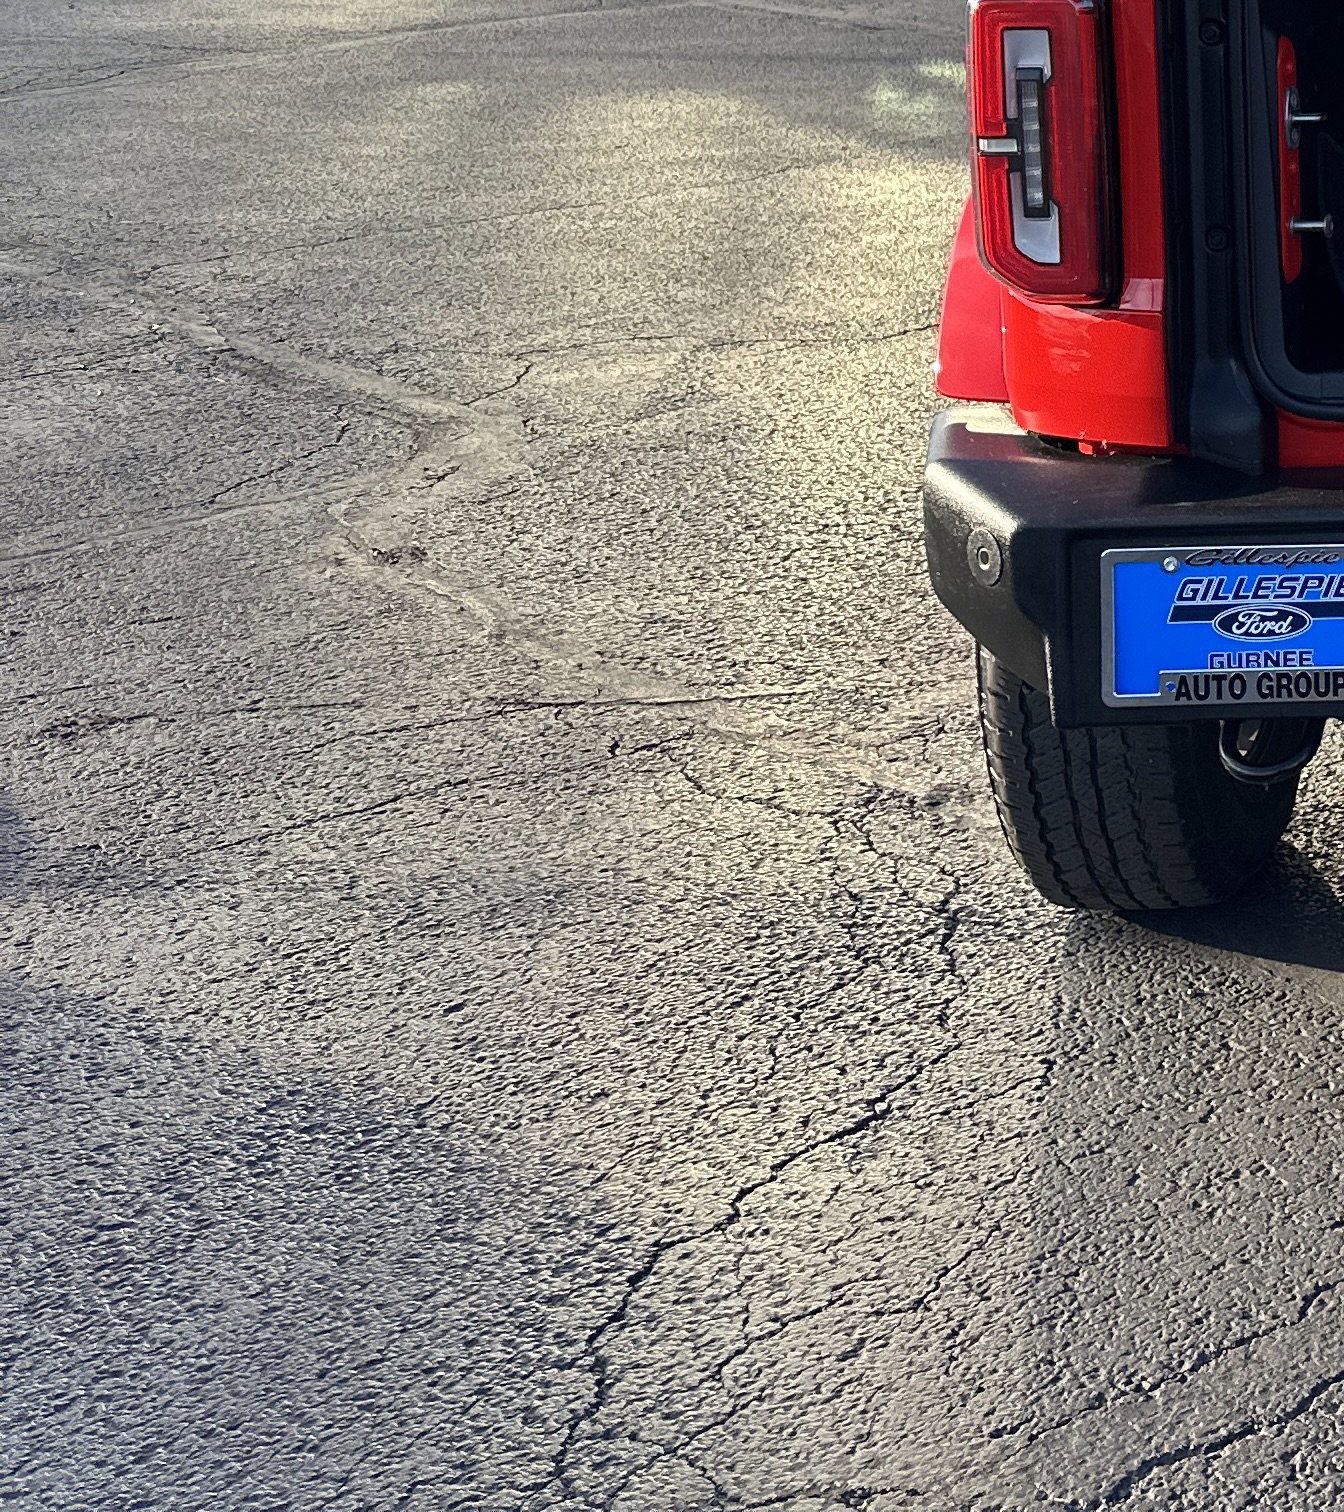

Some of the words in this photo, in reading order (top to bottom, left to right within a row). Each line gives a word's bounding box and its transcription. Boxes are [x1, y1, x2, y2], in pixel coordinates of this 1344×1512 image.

[1185, 548, 1341, 568] Gillespie
[1232, 610, 1293, 635] Ford
[1208, 648, 1315, 669] GURNEE
[1174, 672, 1247, 702] AUTO
